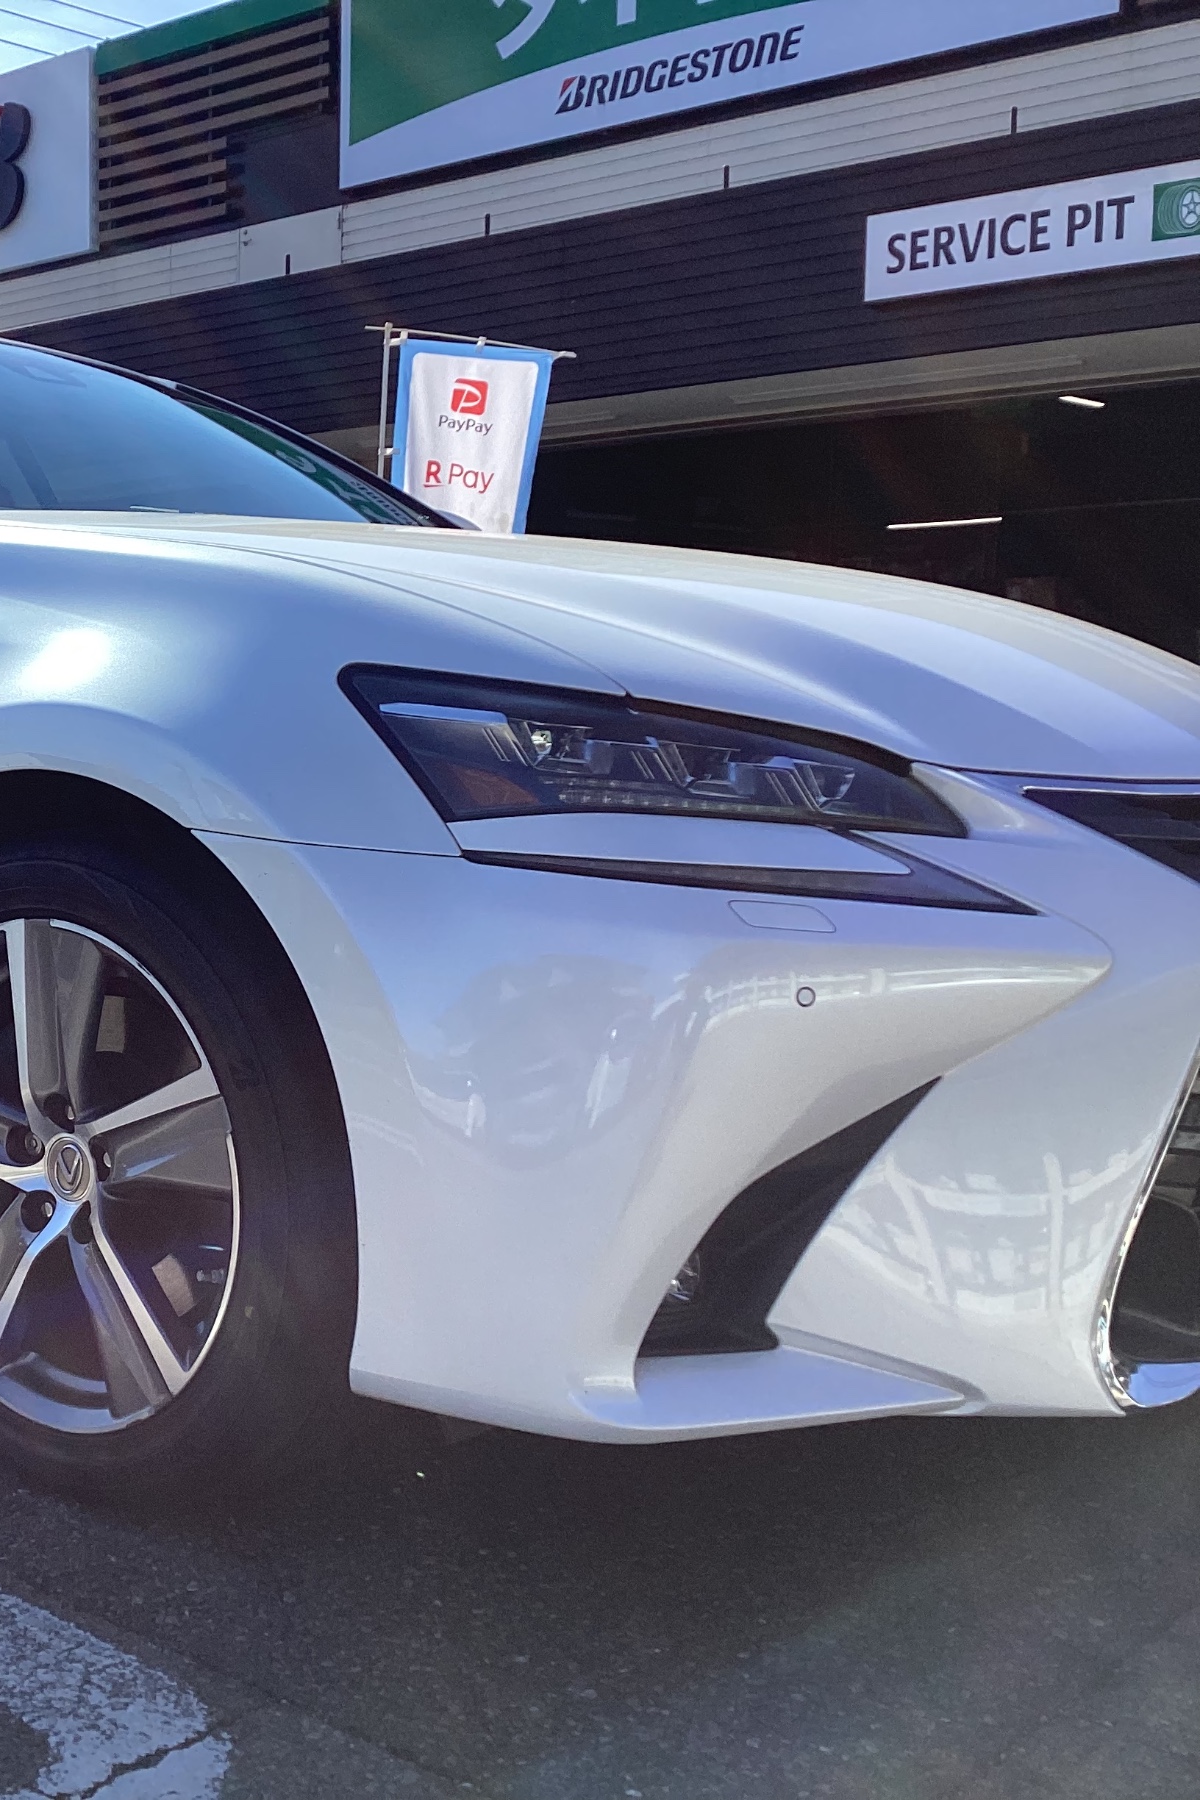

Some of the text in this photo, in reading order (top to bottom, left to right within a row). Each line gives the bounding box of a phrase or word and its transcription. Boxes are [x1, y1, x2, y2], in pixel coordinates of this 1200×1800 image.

[555, 25, 805, 115] BRIDGESTONE
[886, 195, 1135, 274] SERVICE PIT
[438, 414, 493, 437] PayPay
[448, 462, 495, 494] Pay
